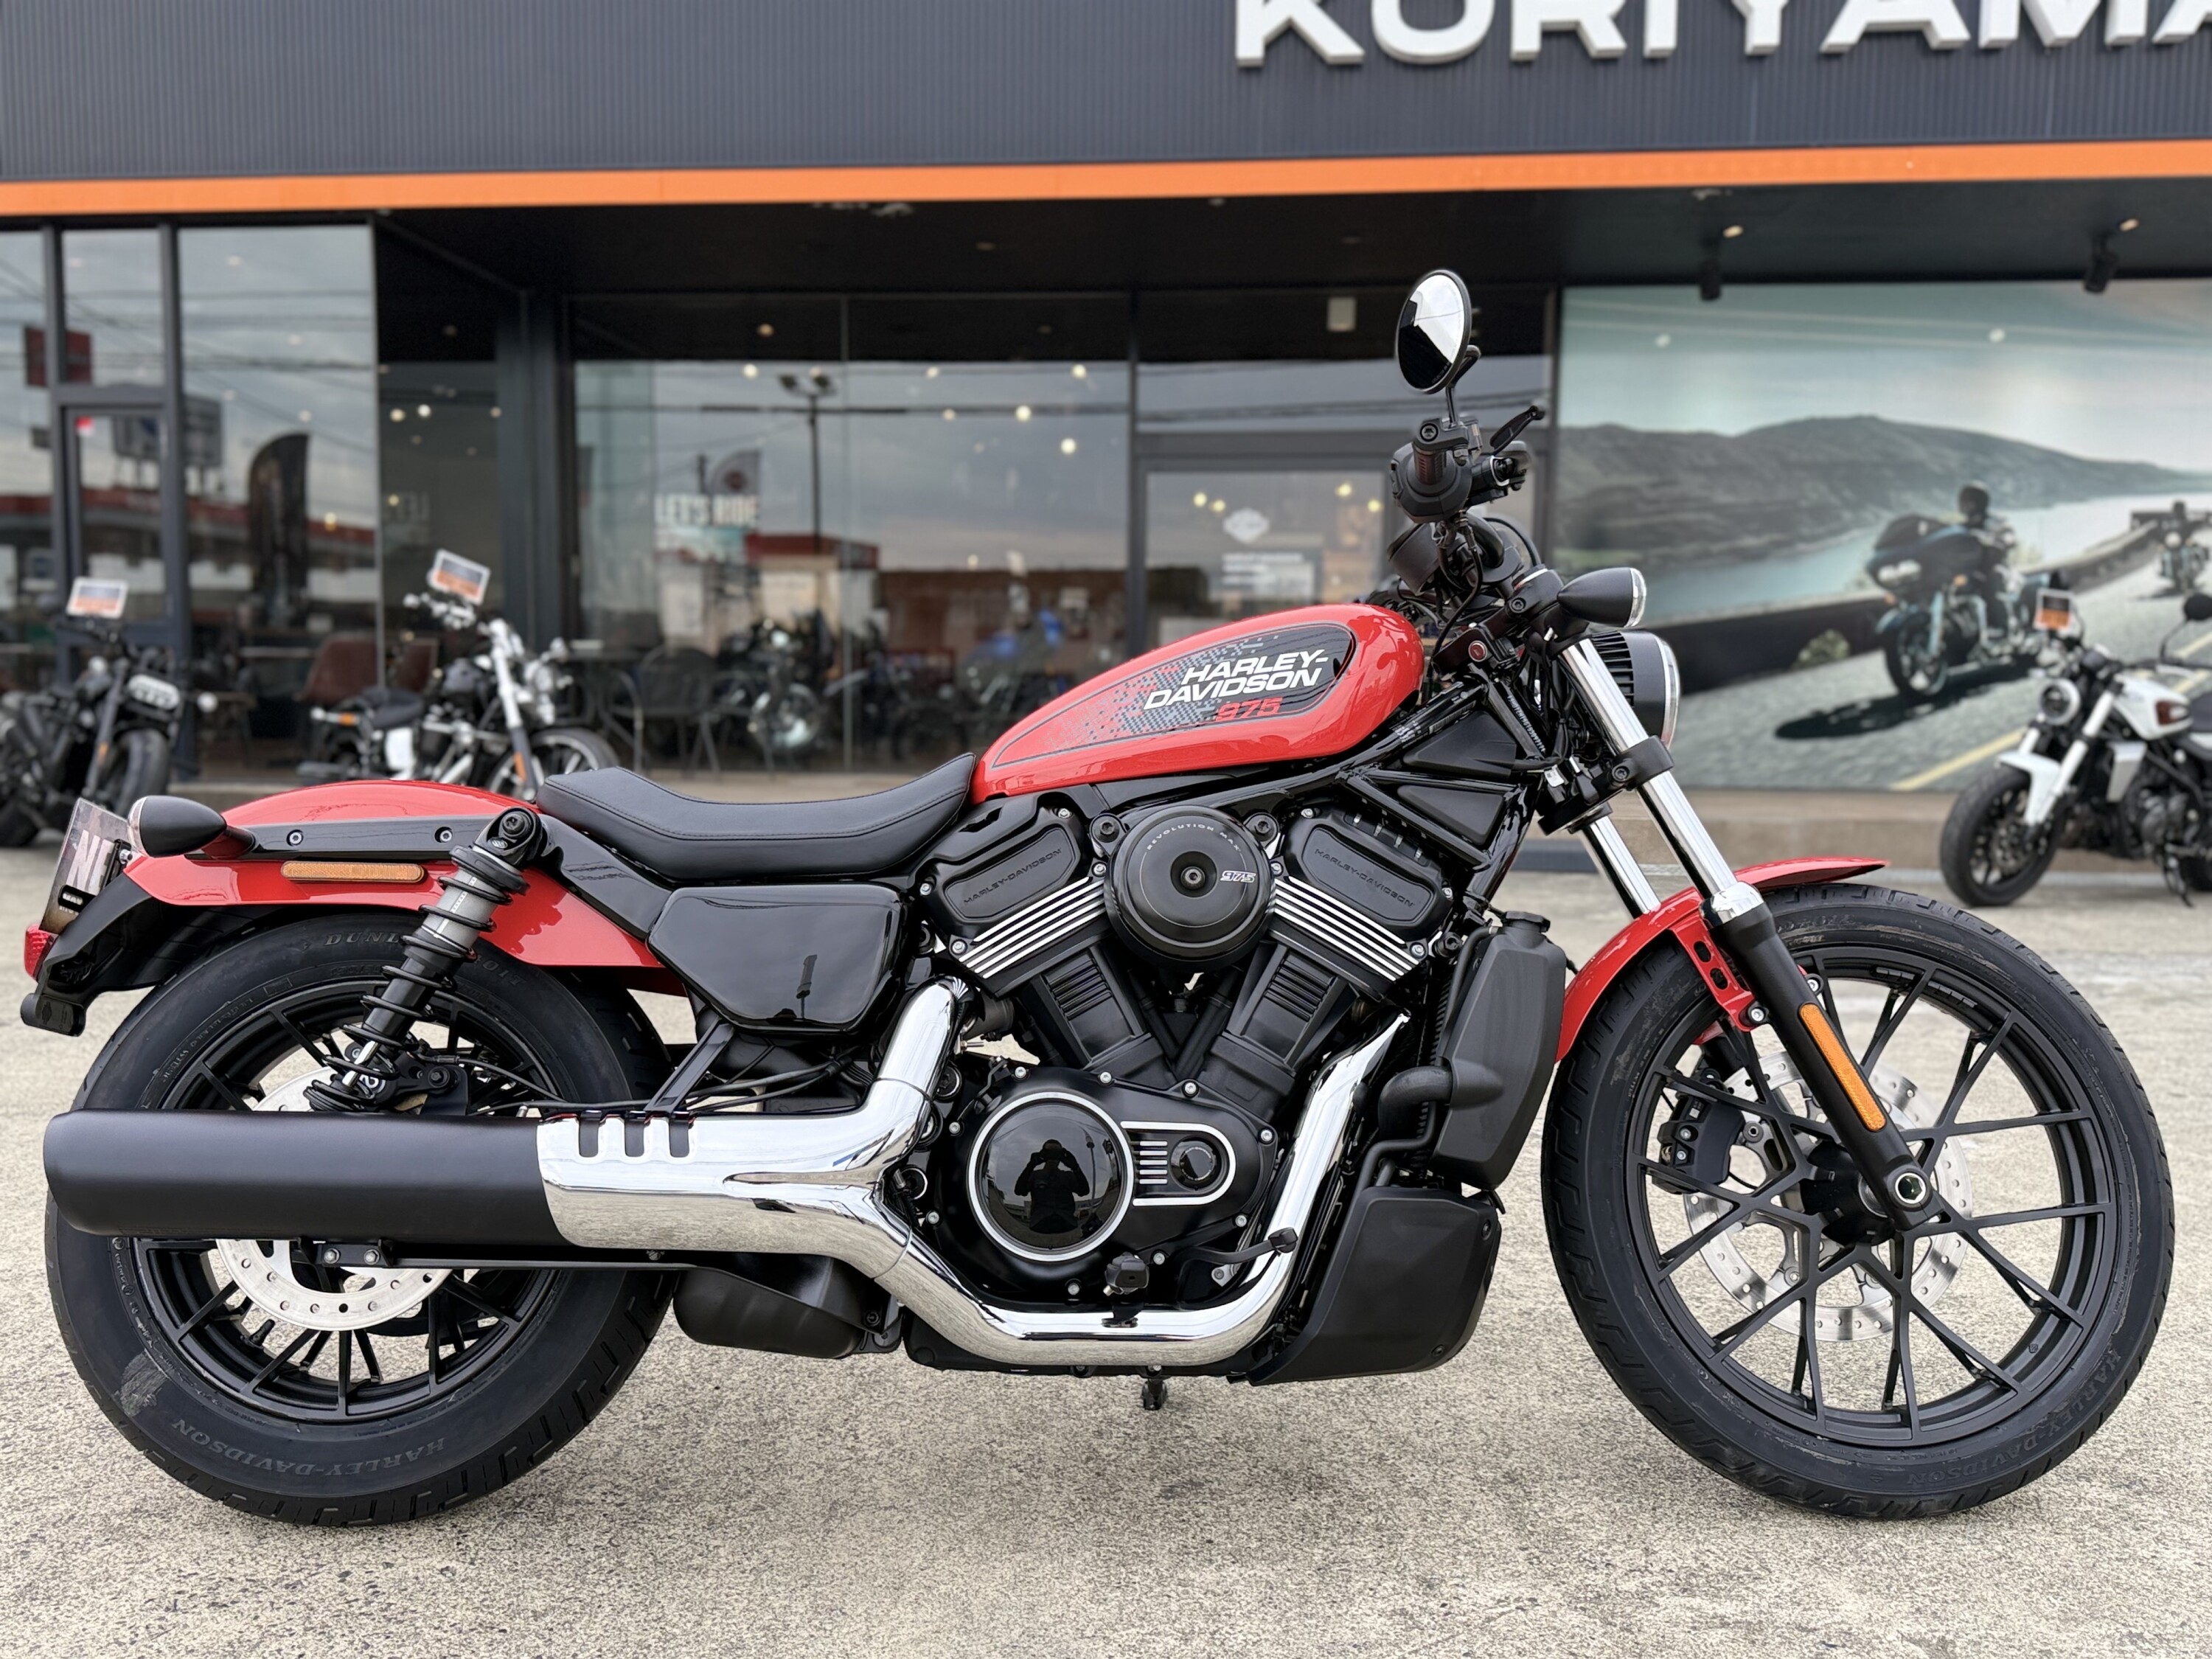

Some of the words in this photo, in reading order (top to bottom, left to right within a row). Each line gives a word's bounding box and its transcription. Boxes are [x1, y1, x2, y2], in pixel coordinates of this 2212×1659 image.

[1144, 667, 1323, 710] DAVIDSON
[1180, 649, 1329, 685] HARLEY-
[1216, 696, 1284, 722] 975
[1147, 823, 1214, 851] REVOLUTION
[1219, 832, 1240, 852] MAX
[963, 848, 1062, 904] HARLEY-DAVIDSON
[1220, 870, 1257, 883] 975
[1314, 848, 1415, 908] HARLEY-DAVIDSON
[1906, 1349, 2122, 1486] HARLEY-DAVIDSON
[170, 1419, 447, 1476] HARLEY-DAVIDSON
